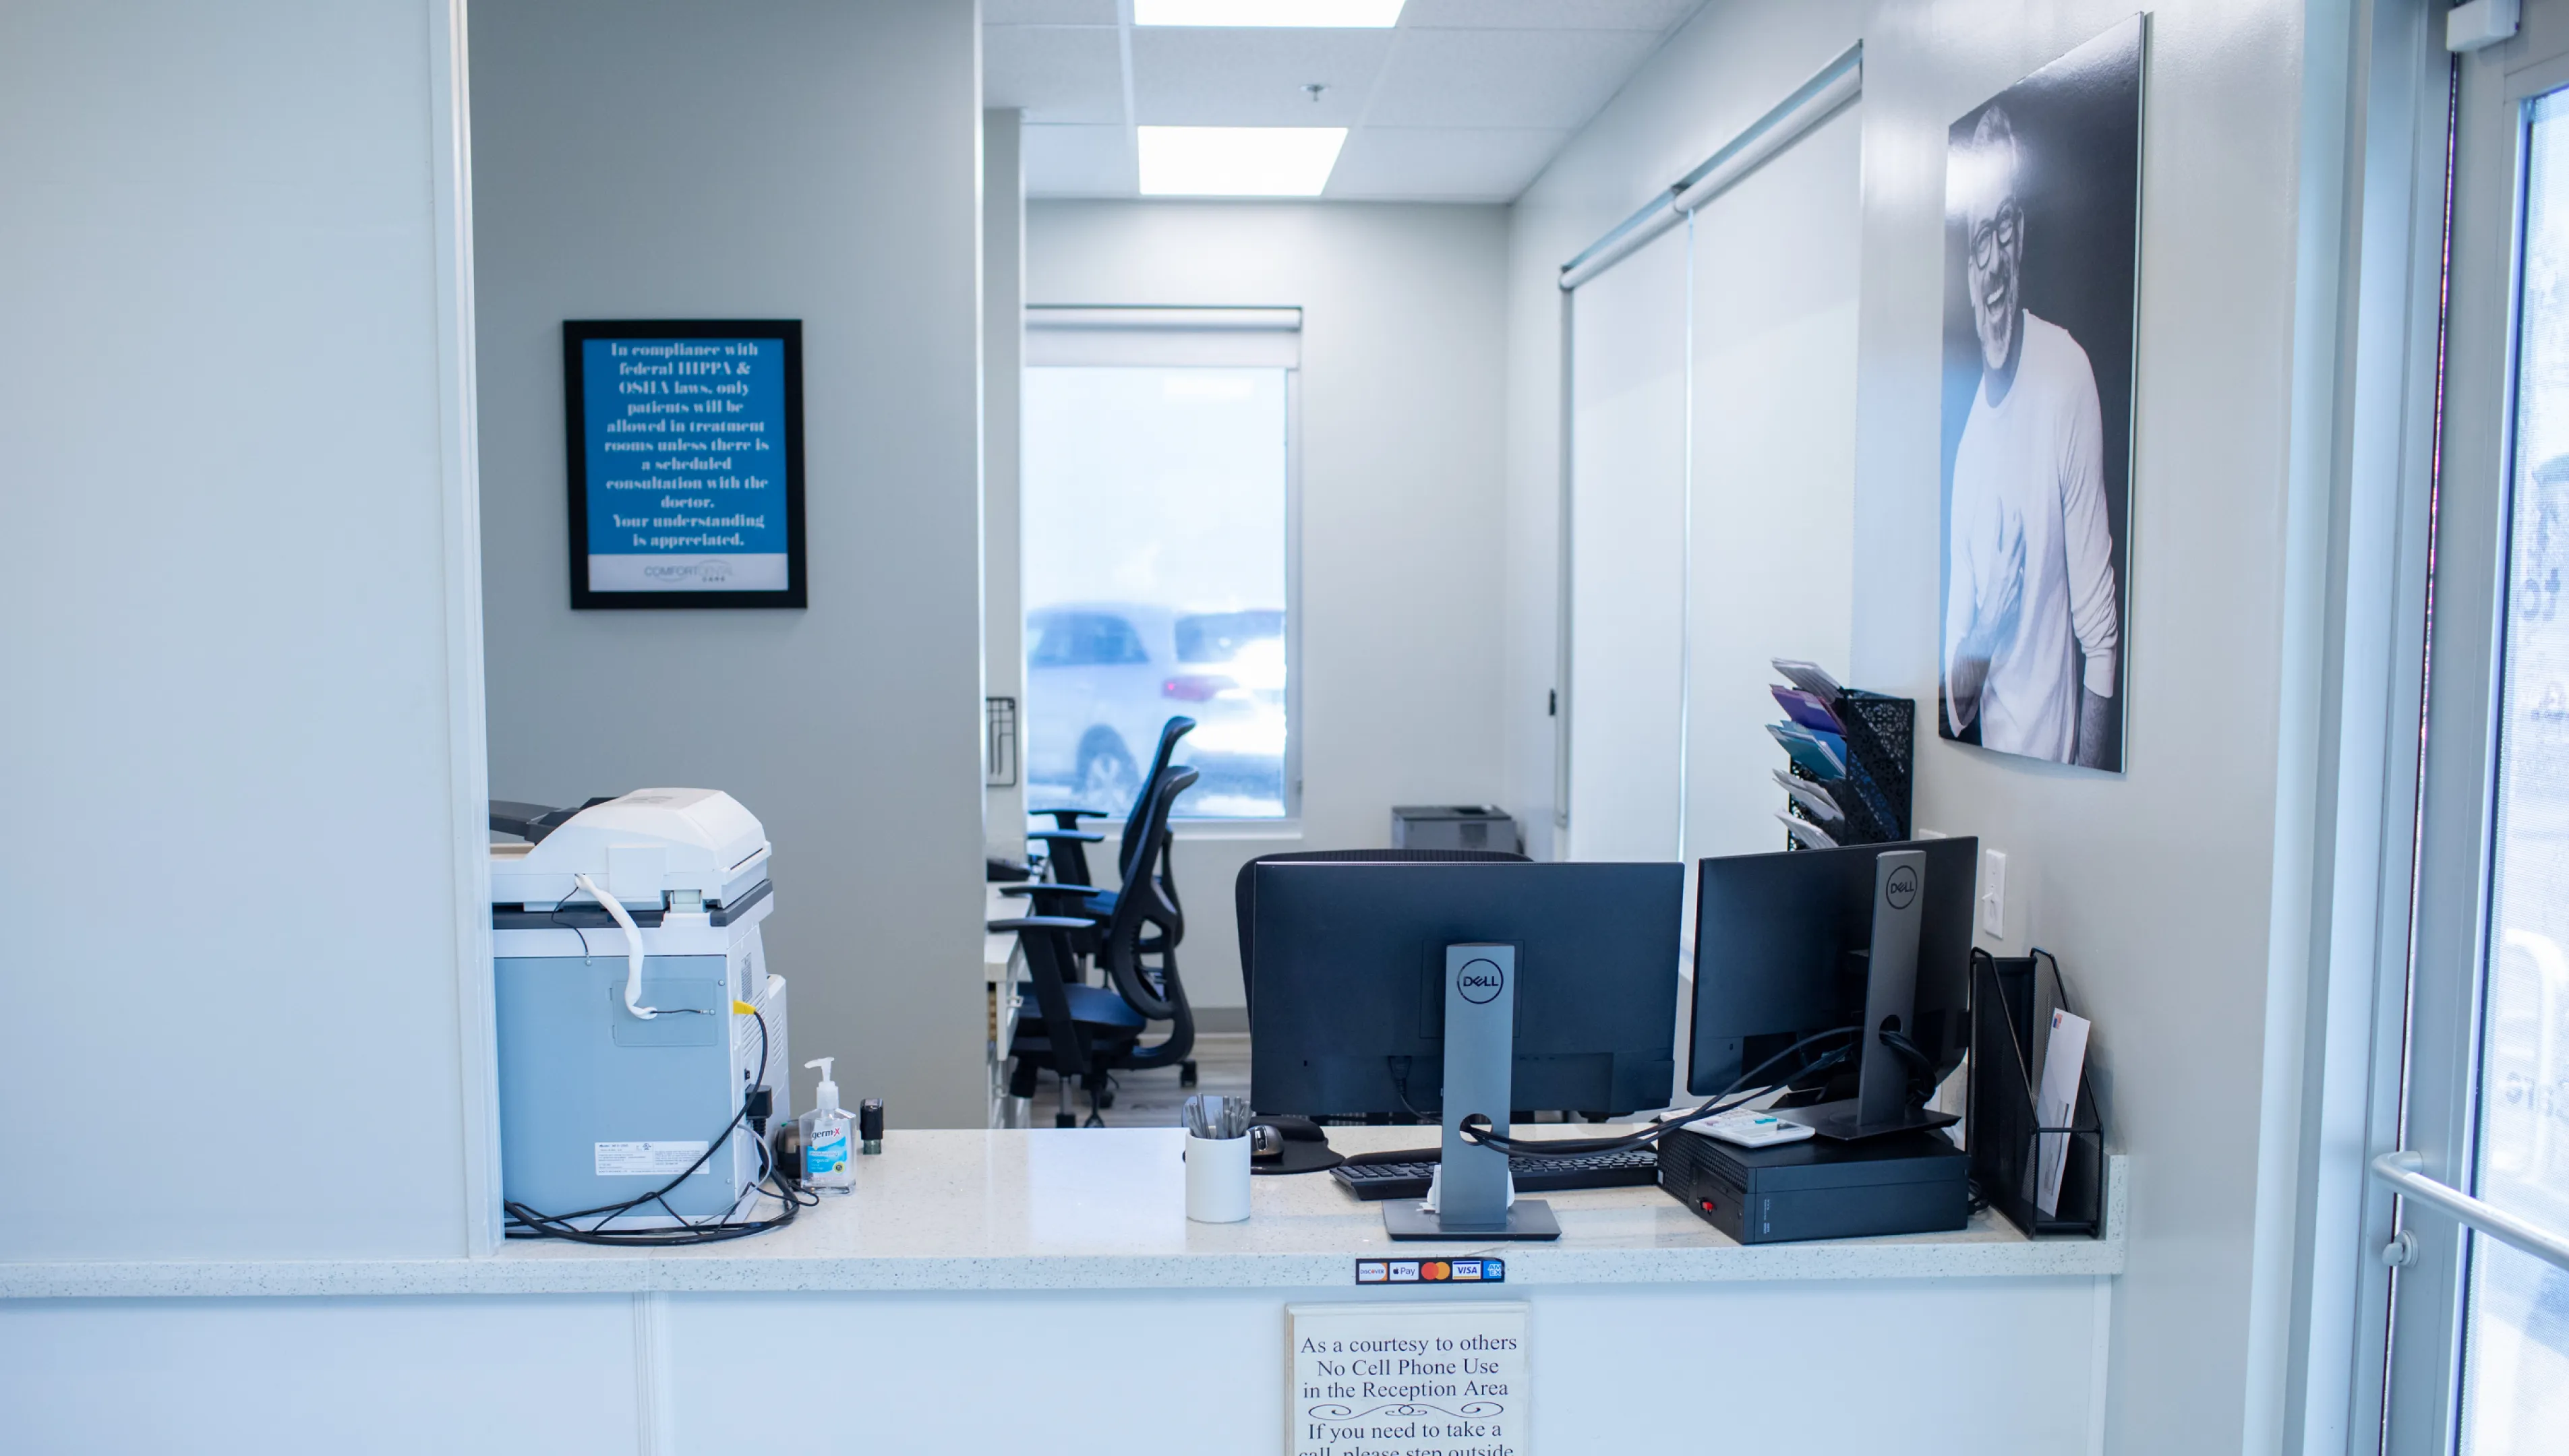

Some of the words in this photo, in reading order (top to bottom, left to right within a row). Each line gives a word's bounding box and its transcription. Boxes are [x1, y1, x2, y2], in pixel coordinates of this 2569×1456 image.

[612, 343, 628, 356] In
[632, 342, 720, 359] compliance
[725, 342, 758, 355] with
[620, 362, 673, 375] federal
[678, 361, 731, 375] HIPPA
[736, 362, 750, 375] &
[618, 381, 669, 394] OSHA
[717, 381, 748, 396] only
[628, 401, 689, 416] patients
[693, 400, 722, 413] will
[726, 400, 743, 412] be
[608, 419, 666, 432] allowed
[670, 420, 685, 432] in
[690, 421, 764, 432] treatment
[605, 442, 653, 451] rooms
[657, 438, 707, 451] unless
[711, 437, 750, 451] there
[756, 438, 769, 450] is
[642, 462, 650, 470] a
[655, 456, 732, 470] scheduled
[606, 476, 702, 489] consultation
[707, 476, 740, 489] with
[744, 475, 768, 489] the
[661, 495, 714, 508] doctor.
[613, 514, 649, 527] Your
[653, 514, 765, 528] understanding
[633, 534, 647, 546] is
[651, 533, 744, 549] appreciated.
[1890, 880, 1914, 894] DELL
[1463, 975, 1499, 987] DELL
[1400, 1267, 1415, 1276] Pay
[1456, 1266, 1477, 1274] VISA
[1301, 1337, 1326, 1353] As
[1333, 1341, 1342, 1352] a
[1350, 1338, 1429, 1356] courtesy
[1436, 1337, 1453, 1351] to
[1460, 1334, 1516, 1350] others
[1318, 1361, 1345, 1376] No
[1353, 1359, 1390, 1375] Cell
[1399, 1359, 1456, 1374] Phone
[1464, 1358, 1498, 1374] Use
[1304, 1383, 1320, 1398] in
[1328, 1382, 1355, 1397] the
[1363, 1381, 1456, 1401] Reception
[1464, 1381, 1508, 1395] Area
[1309, 1424, 1326, 1438] If
[1330, 1428, 1364, 1443] you
[1371, 1422, 1415, 1438] need
[1423, 1424, 1440, 1437] to
[1447, 1421, 1485, 1437] take
[1492, 1426, 1501, 1436] a
